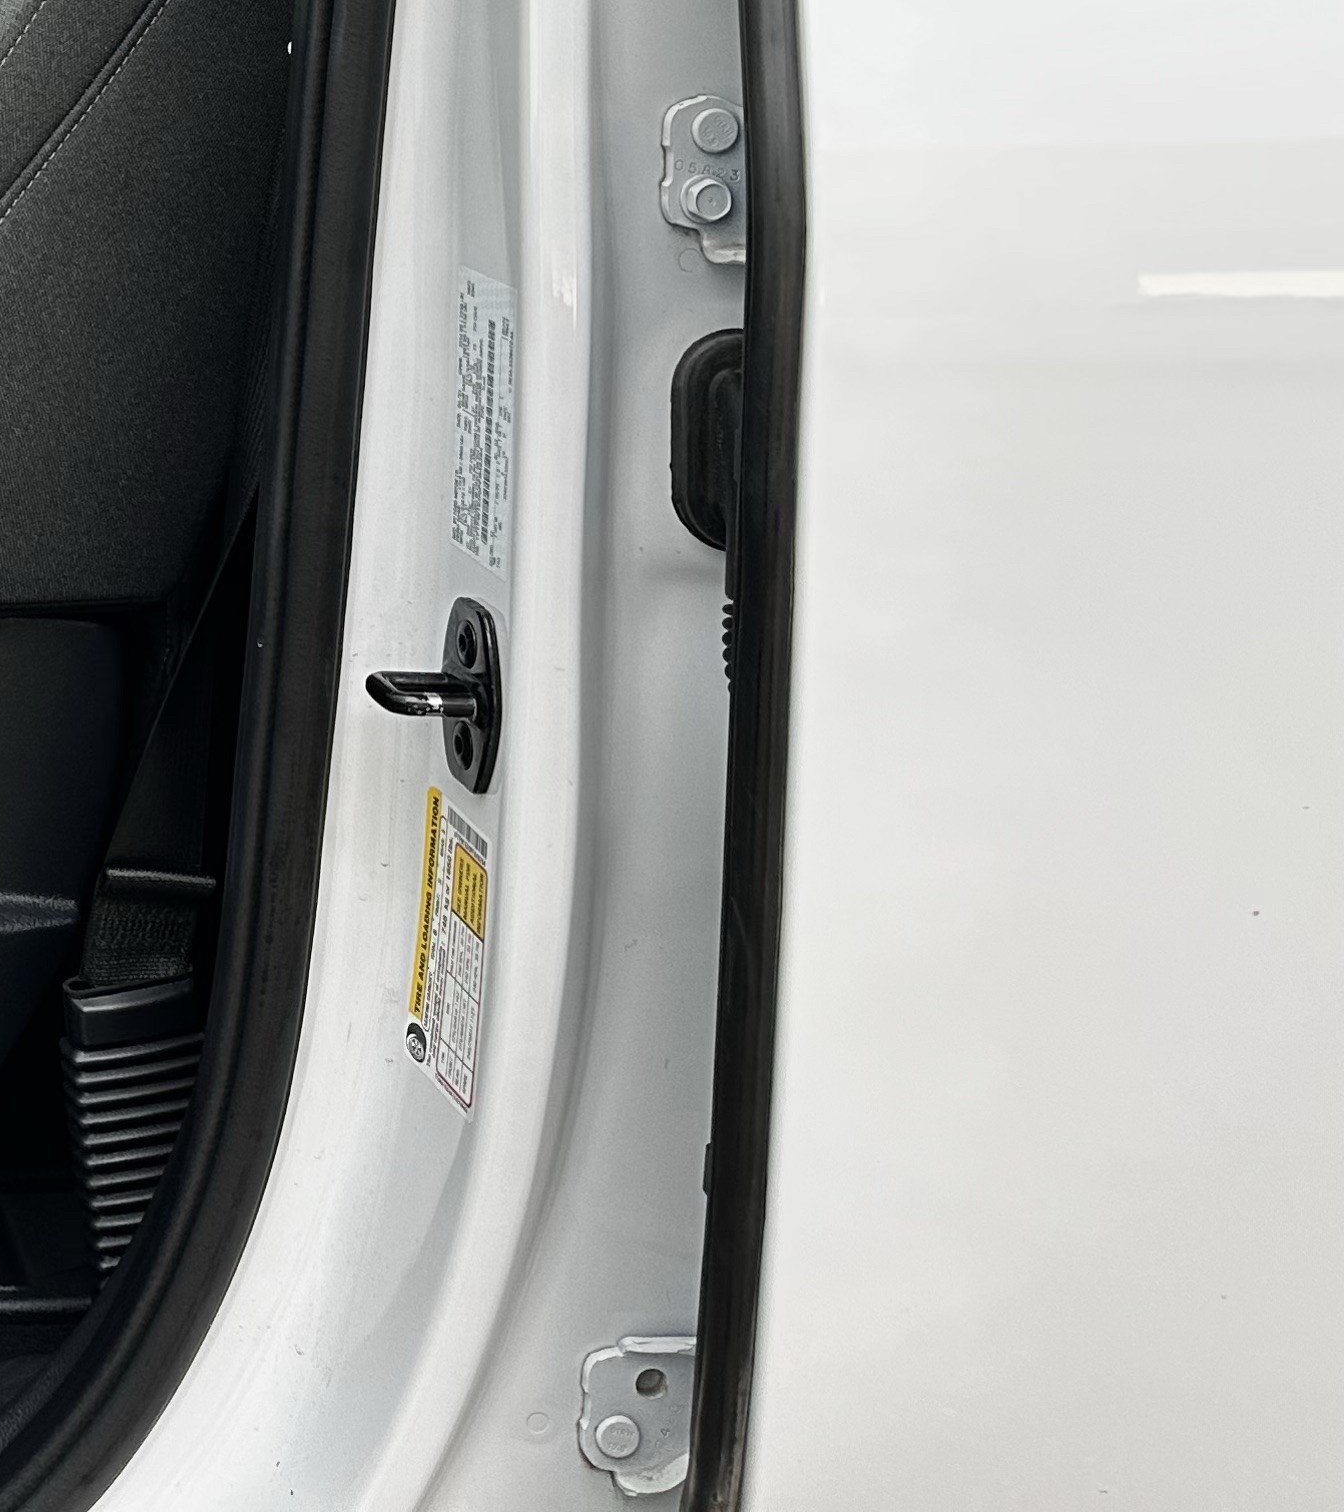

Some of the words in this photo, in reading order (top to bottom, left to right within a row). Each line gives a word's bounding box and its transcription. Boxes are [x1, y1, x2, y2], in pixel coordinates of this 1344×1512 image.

[425, 796, 439, 888] INFORMATION
[420, 890, 431, 951] LOADING
[417, 951, 426, 982] AND
[414, 981, 423, 1015] TIRE
